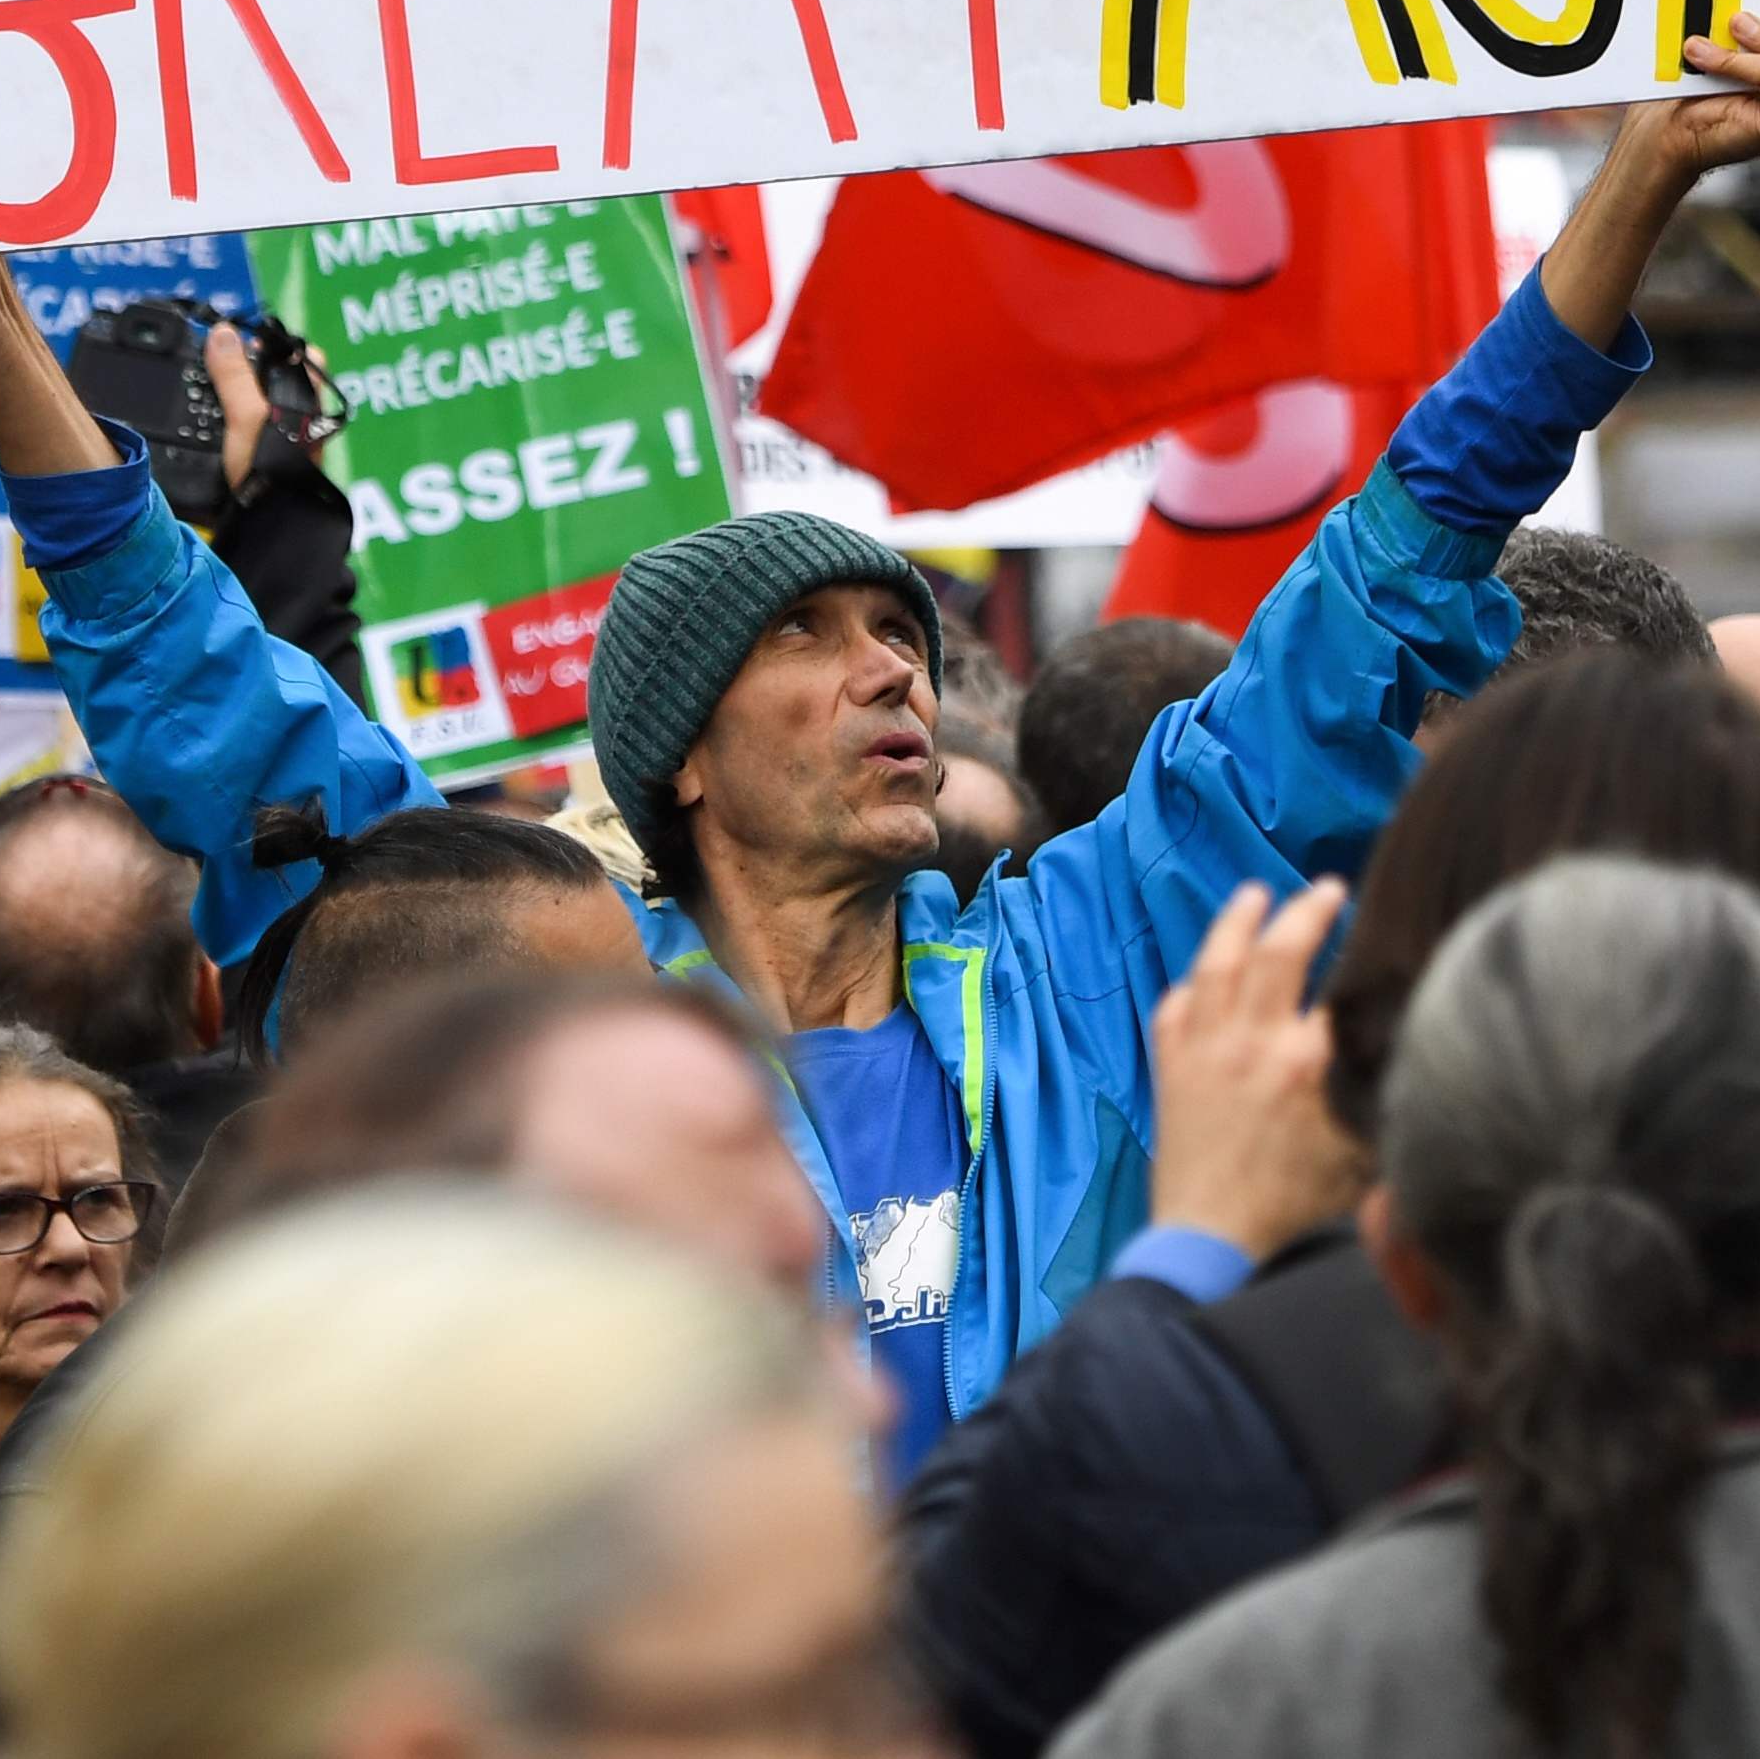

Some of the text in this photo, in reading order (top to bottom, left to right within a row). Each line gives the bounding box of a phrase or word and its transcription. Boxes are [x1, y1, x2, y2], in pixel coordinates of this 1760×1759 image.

[311, 214, 427, 275] MAL
[341, 239, 604, 343] MÉPRISÉ-E
[334, 306, 641, 421] PRÉCARISÉ-E
[348, 405, 702, 553] ASSEZ !
